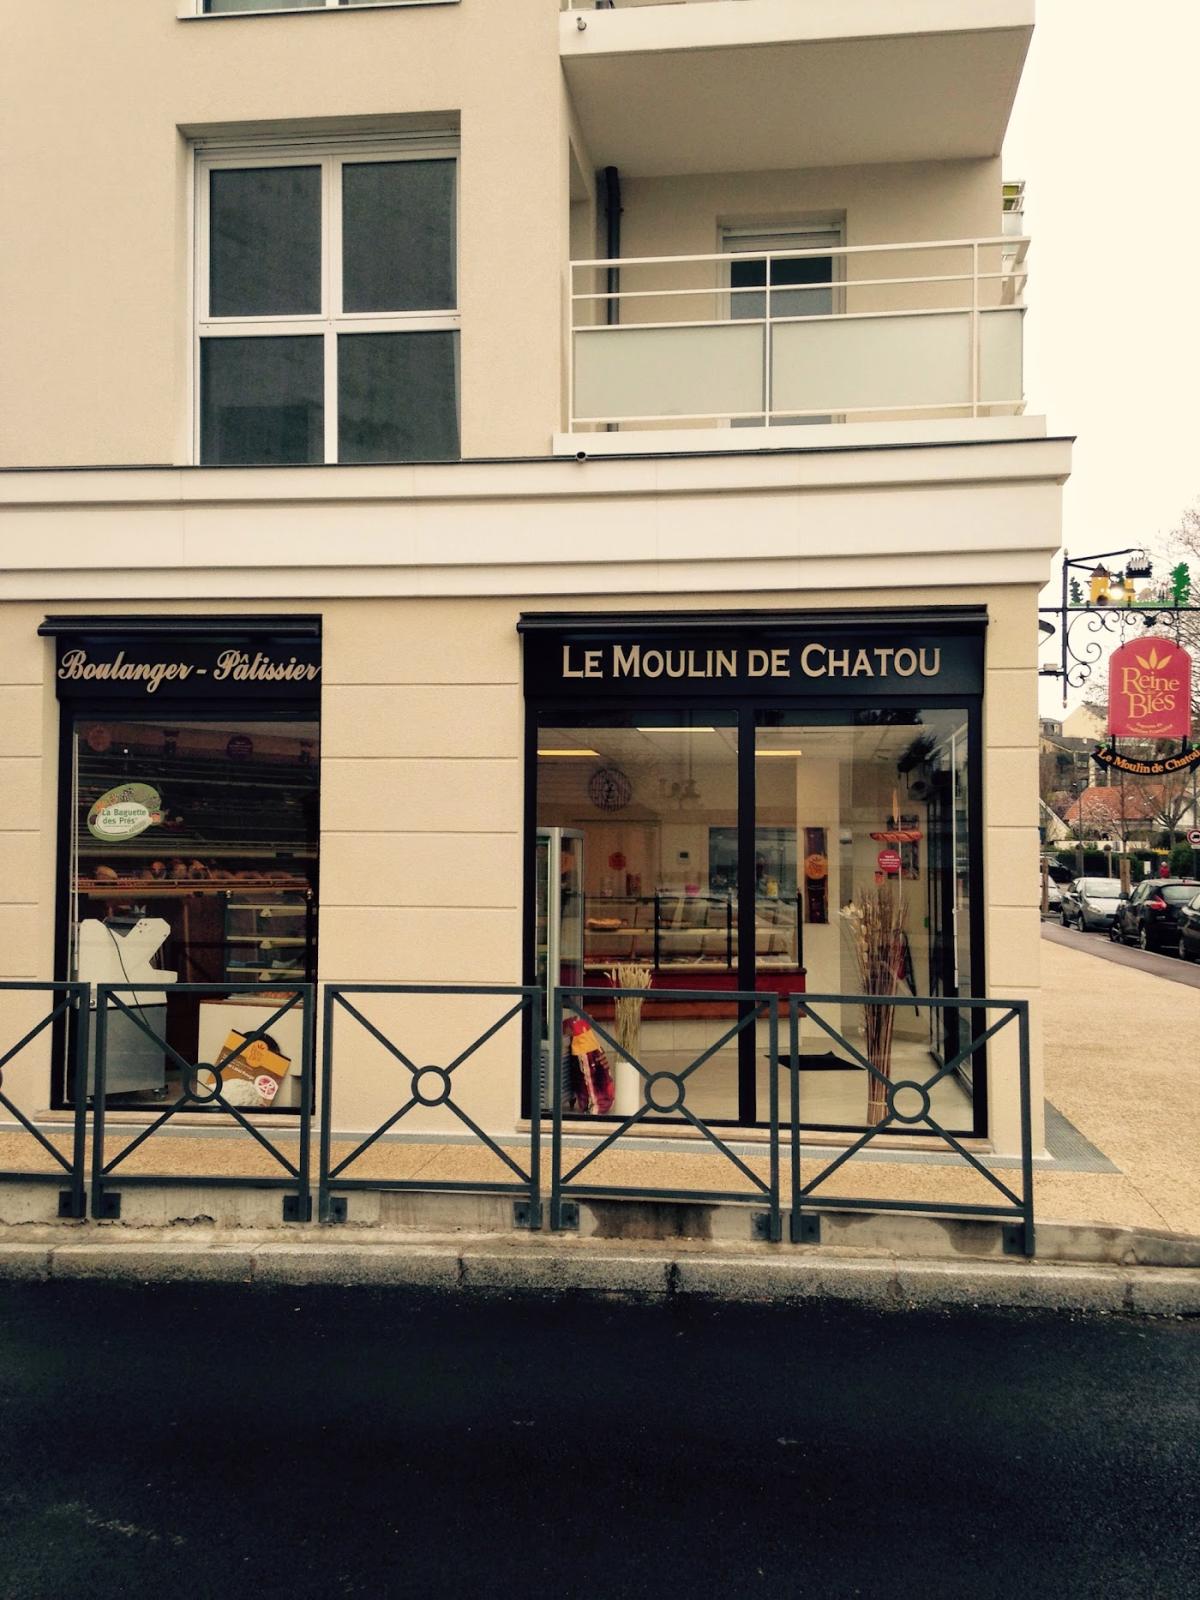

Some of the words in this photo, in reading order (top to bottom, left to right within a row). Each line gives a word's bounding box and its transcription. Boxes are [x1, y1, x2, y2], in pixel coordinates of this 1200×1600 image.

[58, 649, 194, 692] Boulanger
[213, 649, 321, 681] Pâtissier
[562, 645, 602, 678] LE
[613, 645, 738, 678] MOULIN
[748, 649, 790, 677] DE
[801, 643, 940, 678] CHATOU
[1120, 667, 1180, 694] Reine
[1127, 692, 1176, 718] Blés
[1099, 749, 1112, 762] Le
[1113, 757, 1150, 773] Moulin
[1152, 763, 1164, 773] de
[103, 817, 116, 825] des
[119, 817, 135, 825] Prés
[114, 809, 146, 817] Baguette
